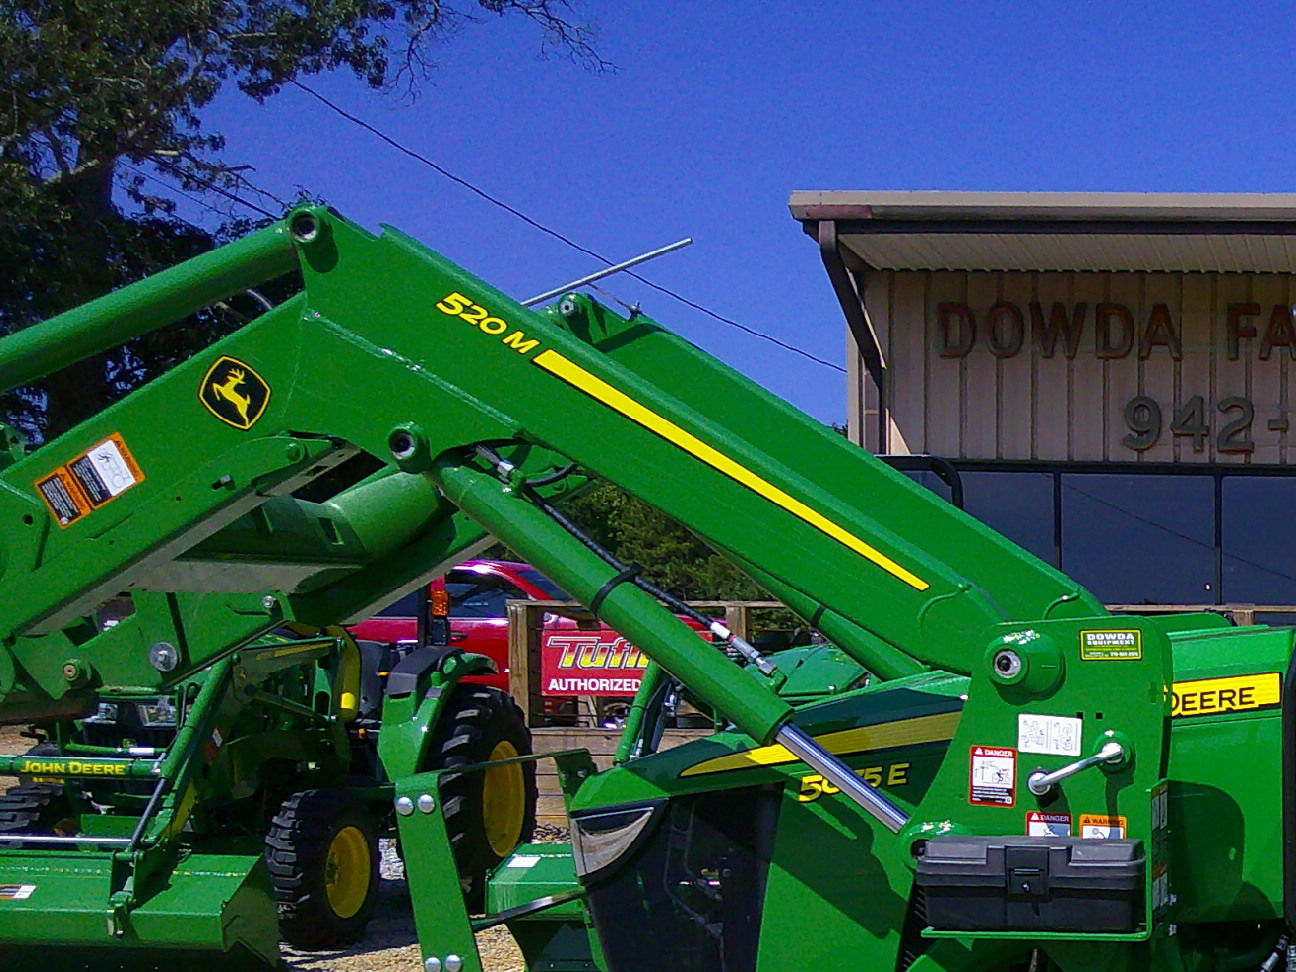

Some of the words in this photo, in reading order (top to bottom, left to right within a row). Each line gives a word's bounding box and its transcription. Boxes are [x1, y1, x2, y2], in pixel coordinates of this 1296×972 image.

[936, 301, 1182, 362] DOWDA
[548, 678, 642, 692] AUTHORIZED
[984, 750, 1013, 758] DANGER
[21, 761, 66, 773] JOHN
[68, 761, 126, 775] DEERE
[1041, 814, 1070, 822] DANGER
